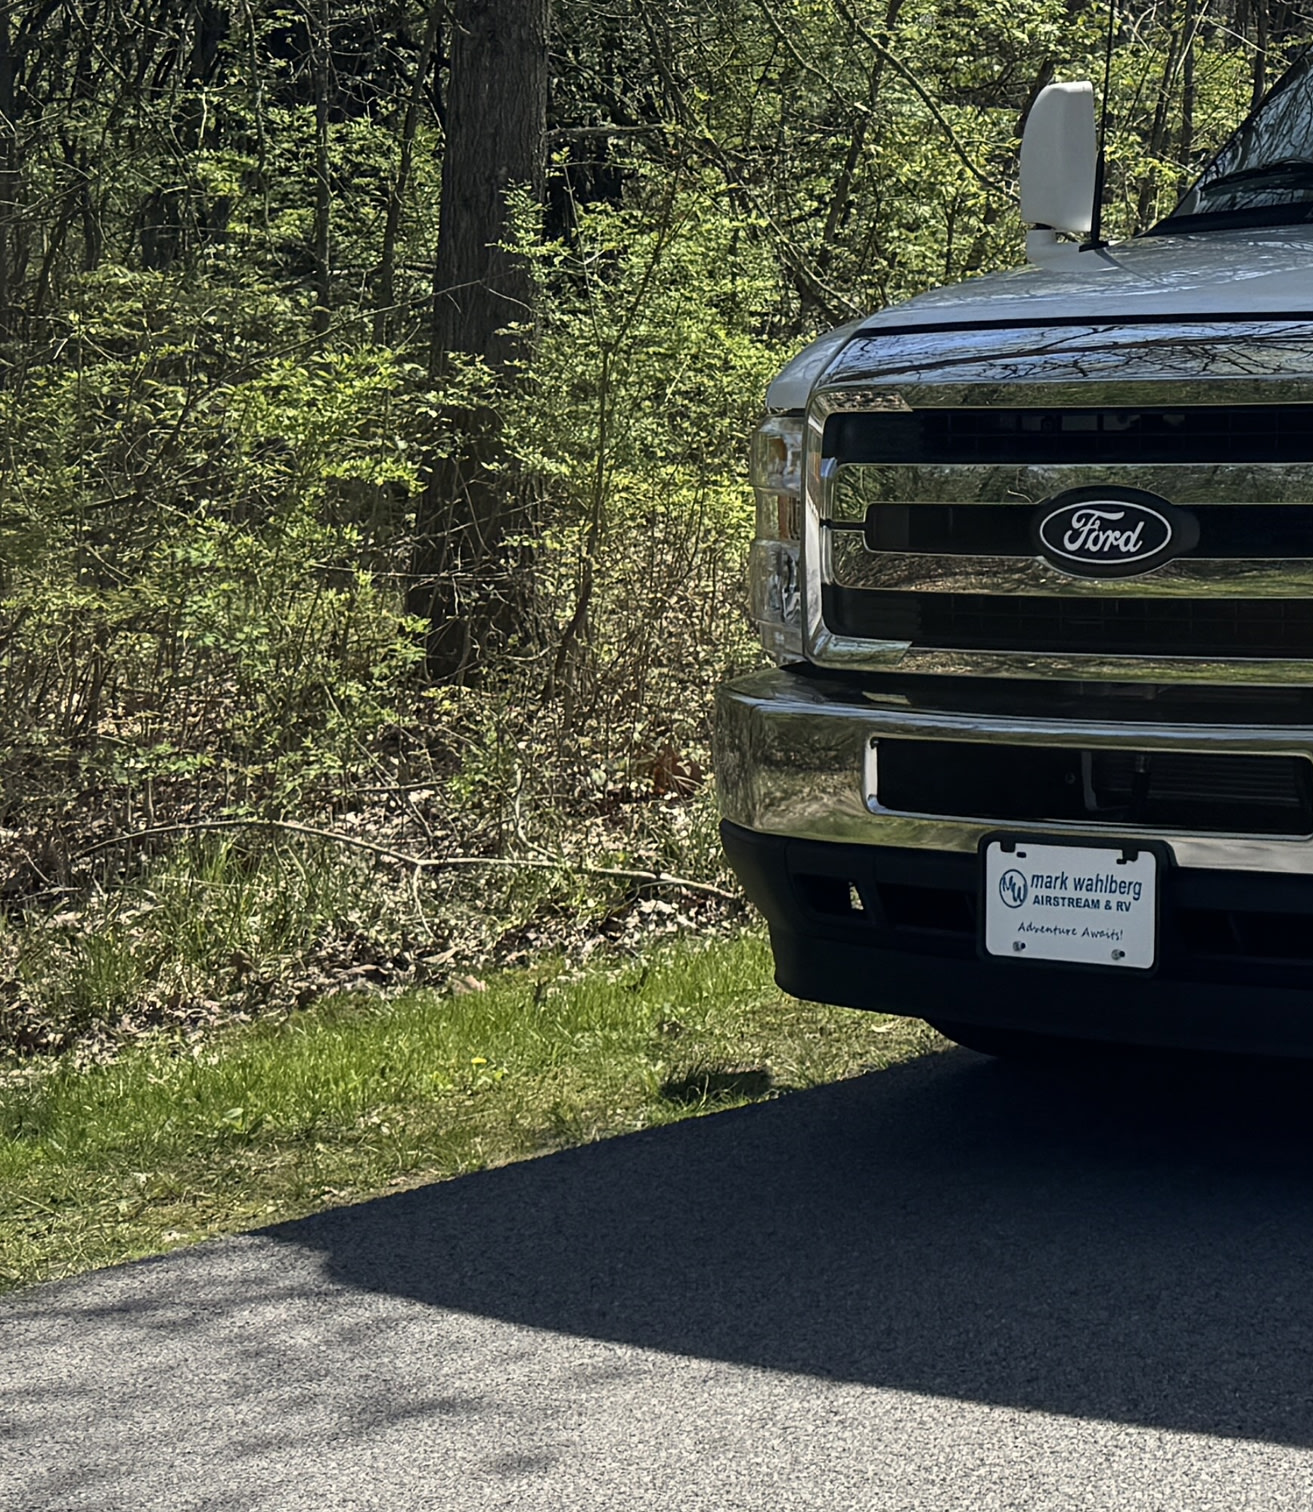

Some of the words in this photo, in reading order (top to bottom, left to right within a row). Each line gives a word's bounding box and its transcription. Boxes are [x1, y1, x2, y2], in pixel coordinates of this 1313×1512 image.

[1063, 509, 1145, 552] Ford
[1031, 871, 1068, 890] mark
[1073, 873, 1142, 901] wahlberg
[1032, 895, 1100, 910] AIRSTREAM
[1104, 899, 1112, 910] &
[1116, 900, 1132, 912] RV
[1018, 921, 1077, 937] Adventure
[1081, 927, 1123, 940] Awaits!
